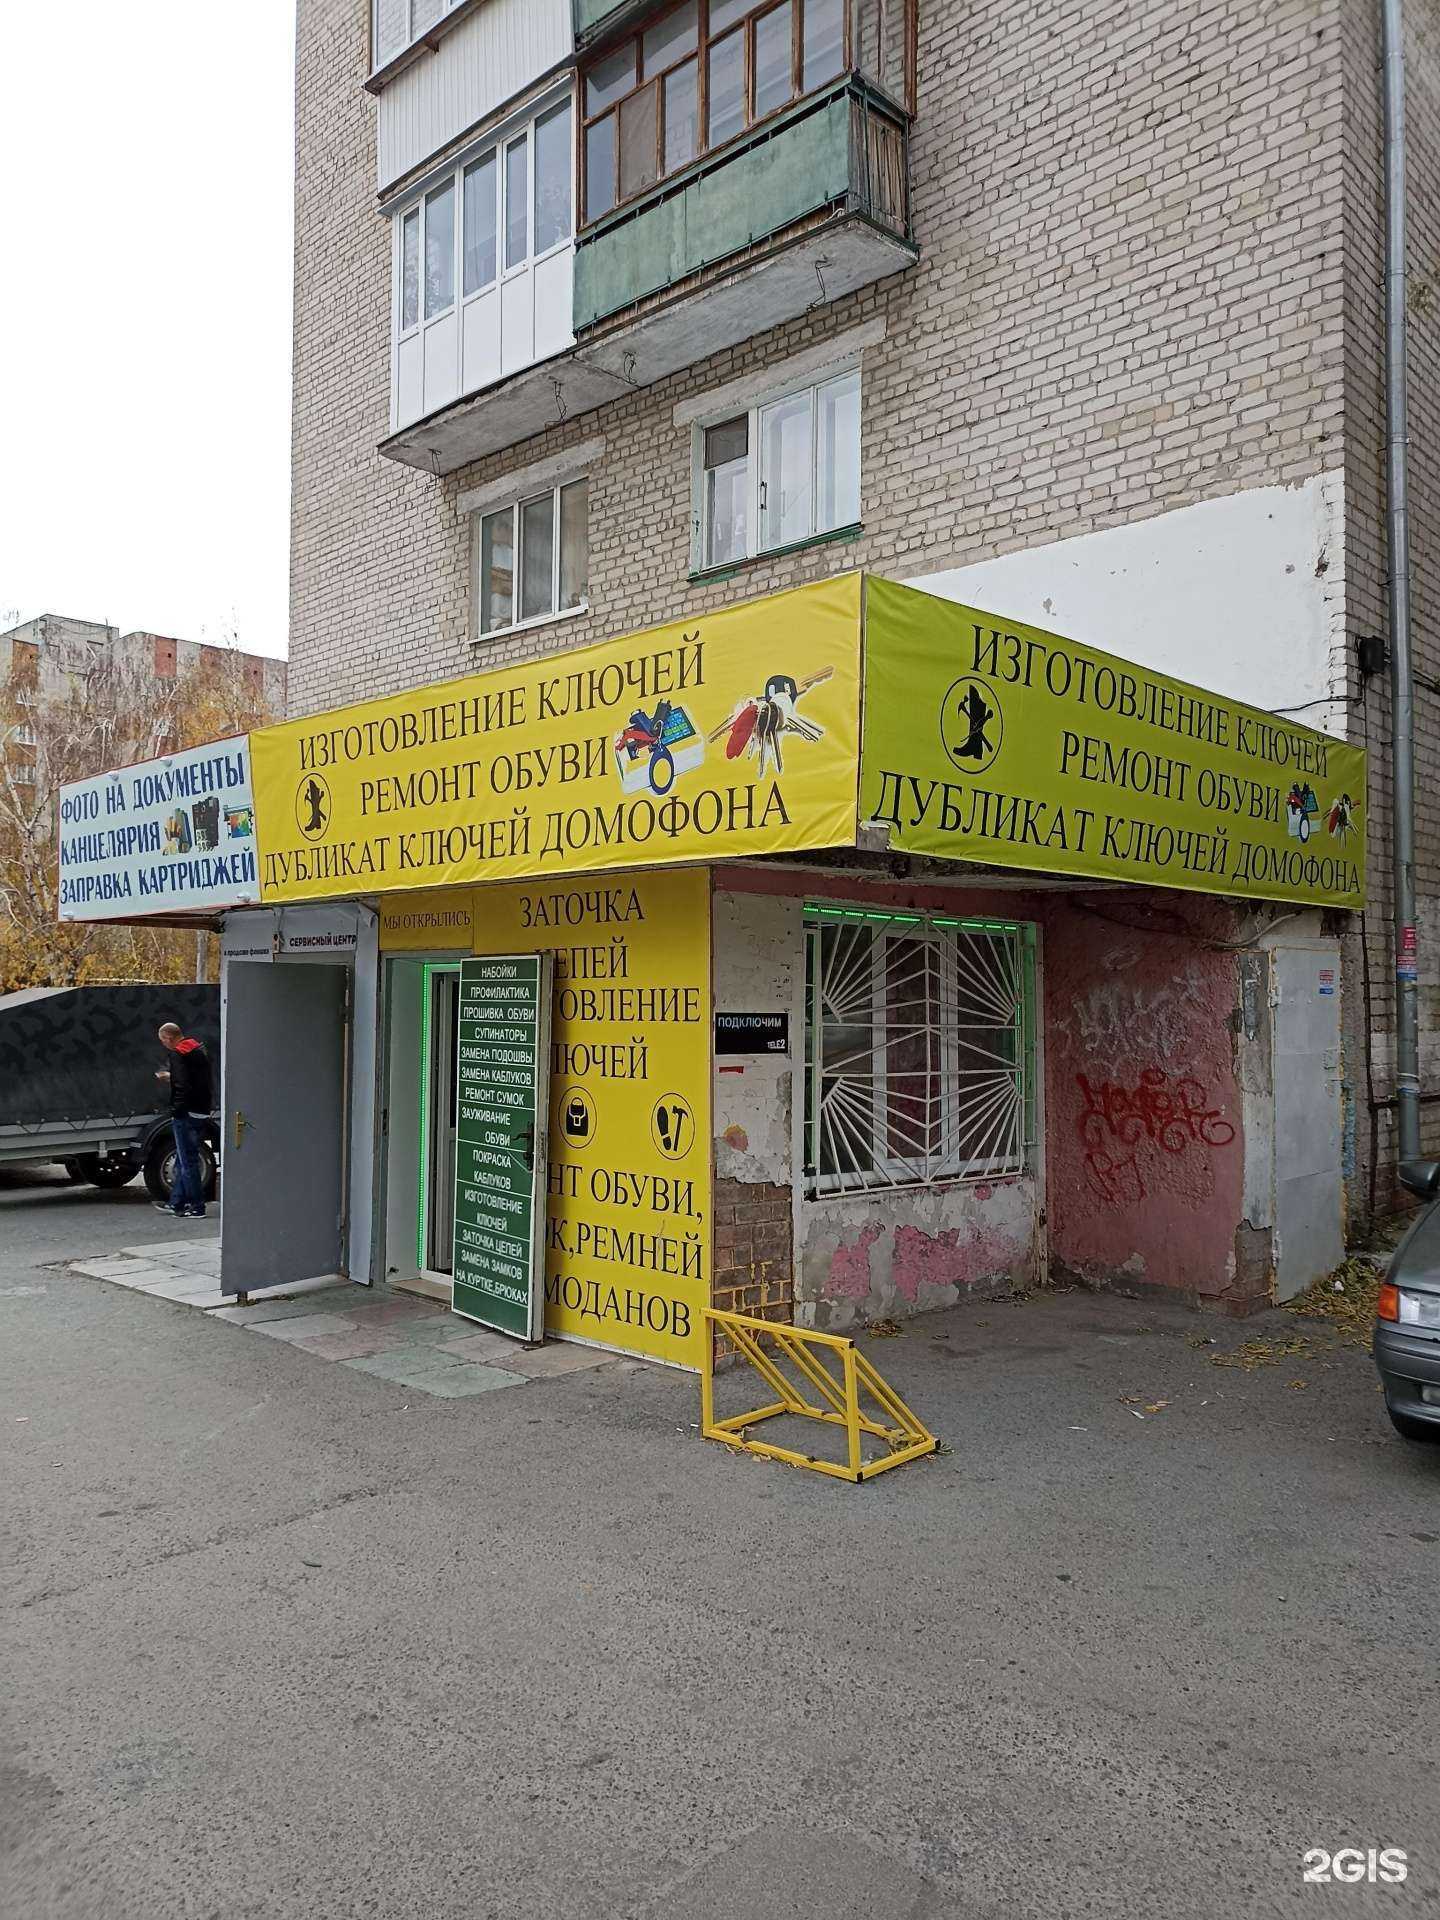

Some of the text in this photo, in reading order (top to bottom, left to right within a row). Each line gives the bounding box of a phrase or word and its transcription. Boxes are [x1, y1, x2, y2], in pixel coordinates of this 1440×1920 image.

[299, 630, 705, 771] ИЗГОТОВЛЕНИЕ КЛЮЧЕЙ
[970, 624, 1328, 778] ИЗГОТОВЛЕНИЕ КЛЮЧЕЙ
[61, 753, 245, 824] ФОТО НА ДОКУМЕНТЫ
[361, 736, 608, 815] РЕМОНТ ОБУВИ
[1059, 731, 1280, 822] РЕМОНТ ОБУВИ
[61, 821, 160, 866] КАНЦЕЛЯРИЯ
[264, 780, 792, 891] ДУБЛИКАТ КЛЮЧЕЙ ДОМОФОНА
[870, 770, 1360, 893] ДУБЛИКАТ КЛЮЧЕЙ ДОМОФОНА
[60, 847, 256, 905] ЗАПРАВКА КАРТРИДЖЕЙ
[384, 911, 471, 929] МЫ ОТКРЫЛИСЬ
[520, 888, 645, 928] ЗАТОЧКА
[290, 932, 357, 947] СЕРВИСНЫЙ ЦЕНТР
[535, 936, 629, 979] ЕПЕЙ
[481, 964, 517, 979] НАБОЙКИ
[470, 986, 530, 999] ПРОФИЛАКТИКА
[553, 987, 701, 1022] ОВЛЕНИЕ
[463, 1006, 535, 1021] ПРОШИВКА ОБУВИ
[718, 1016, 782, 1029] ПОДКЛЮЧИМ
[474, 1027, 527, 1042] СУПИНАТОРЫ
[461, 1046, 533, 1064] ЗАМЕНА ПОДОШВЫ
[461, 1066, 532, 1085] ЗАМЕНА КАБЛУКОВ
[465, 1087, 525, 1106] РЕМОНТ СУМОК
[461, 1106, 511, 1126] ЗАУЖИВАНИЕ
[485, 1131, 511, 1147] ОБУВИ
[472, 1149, 512, 1168] ПОКРАСКА
[473, 1170, 511, 1190] КАБЛУКОВ
[464, 1189, 523, 1215] ИЗГОТОВЛЕНИЕ
[591, 1168, 703, 1224] ОБУВИ,
[476, 1212, 507, 1232] КЛЮЧЕЙ
[462, 1229, 522, 1259] ЗАТОЧКА ЦЕПЕЙ
[546, 1217, 703, 1280] К,РЕМНЕЙ
[456, 1268, 466, 1283] НА
[461, 1249, 523, 1280] ЗАМЕНА ЗАМКОВ
